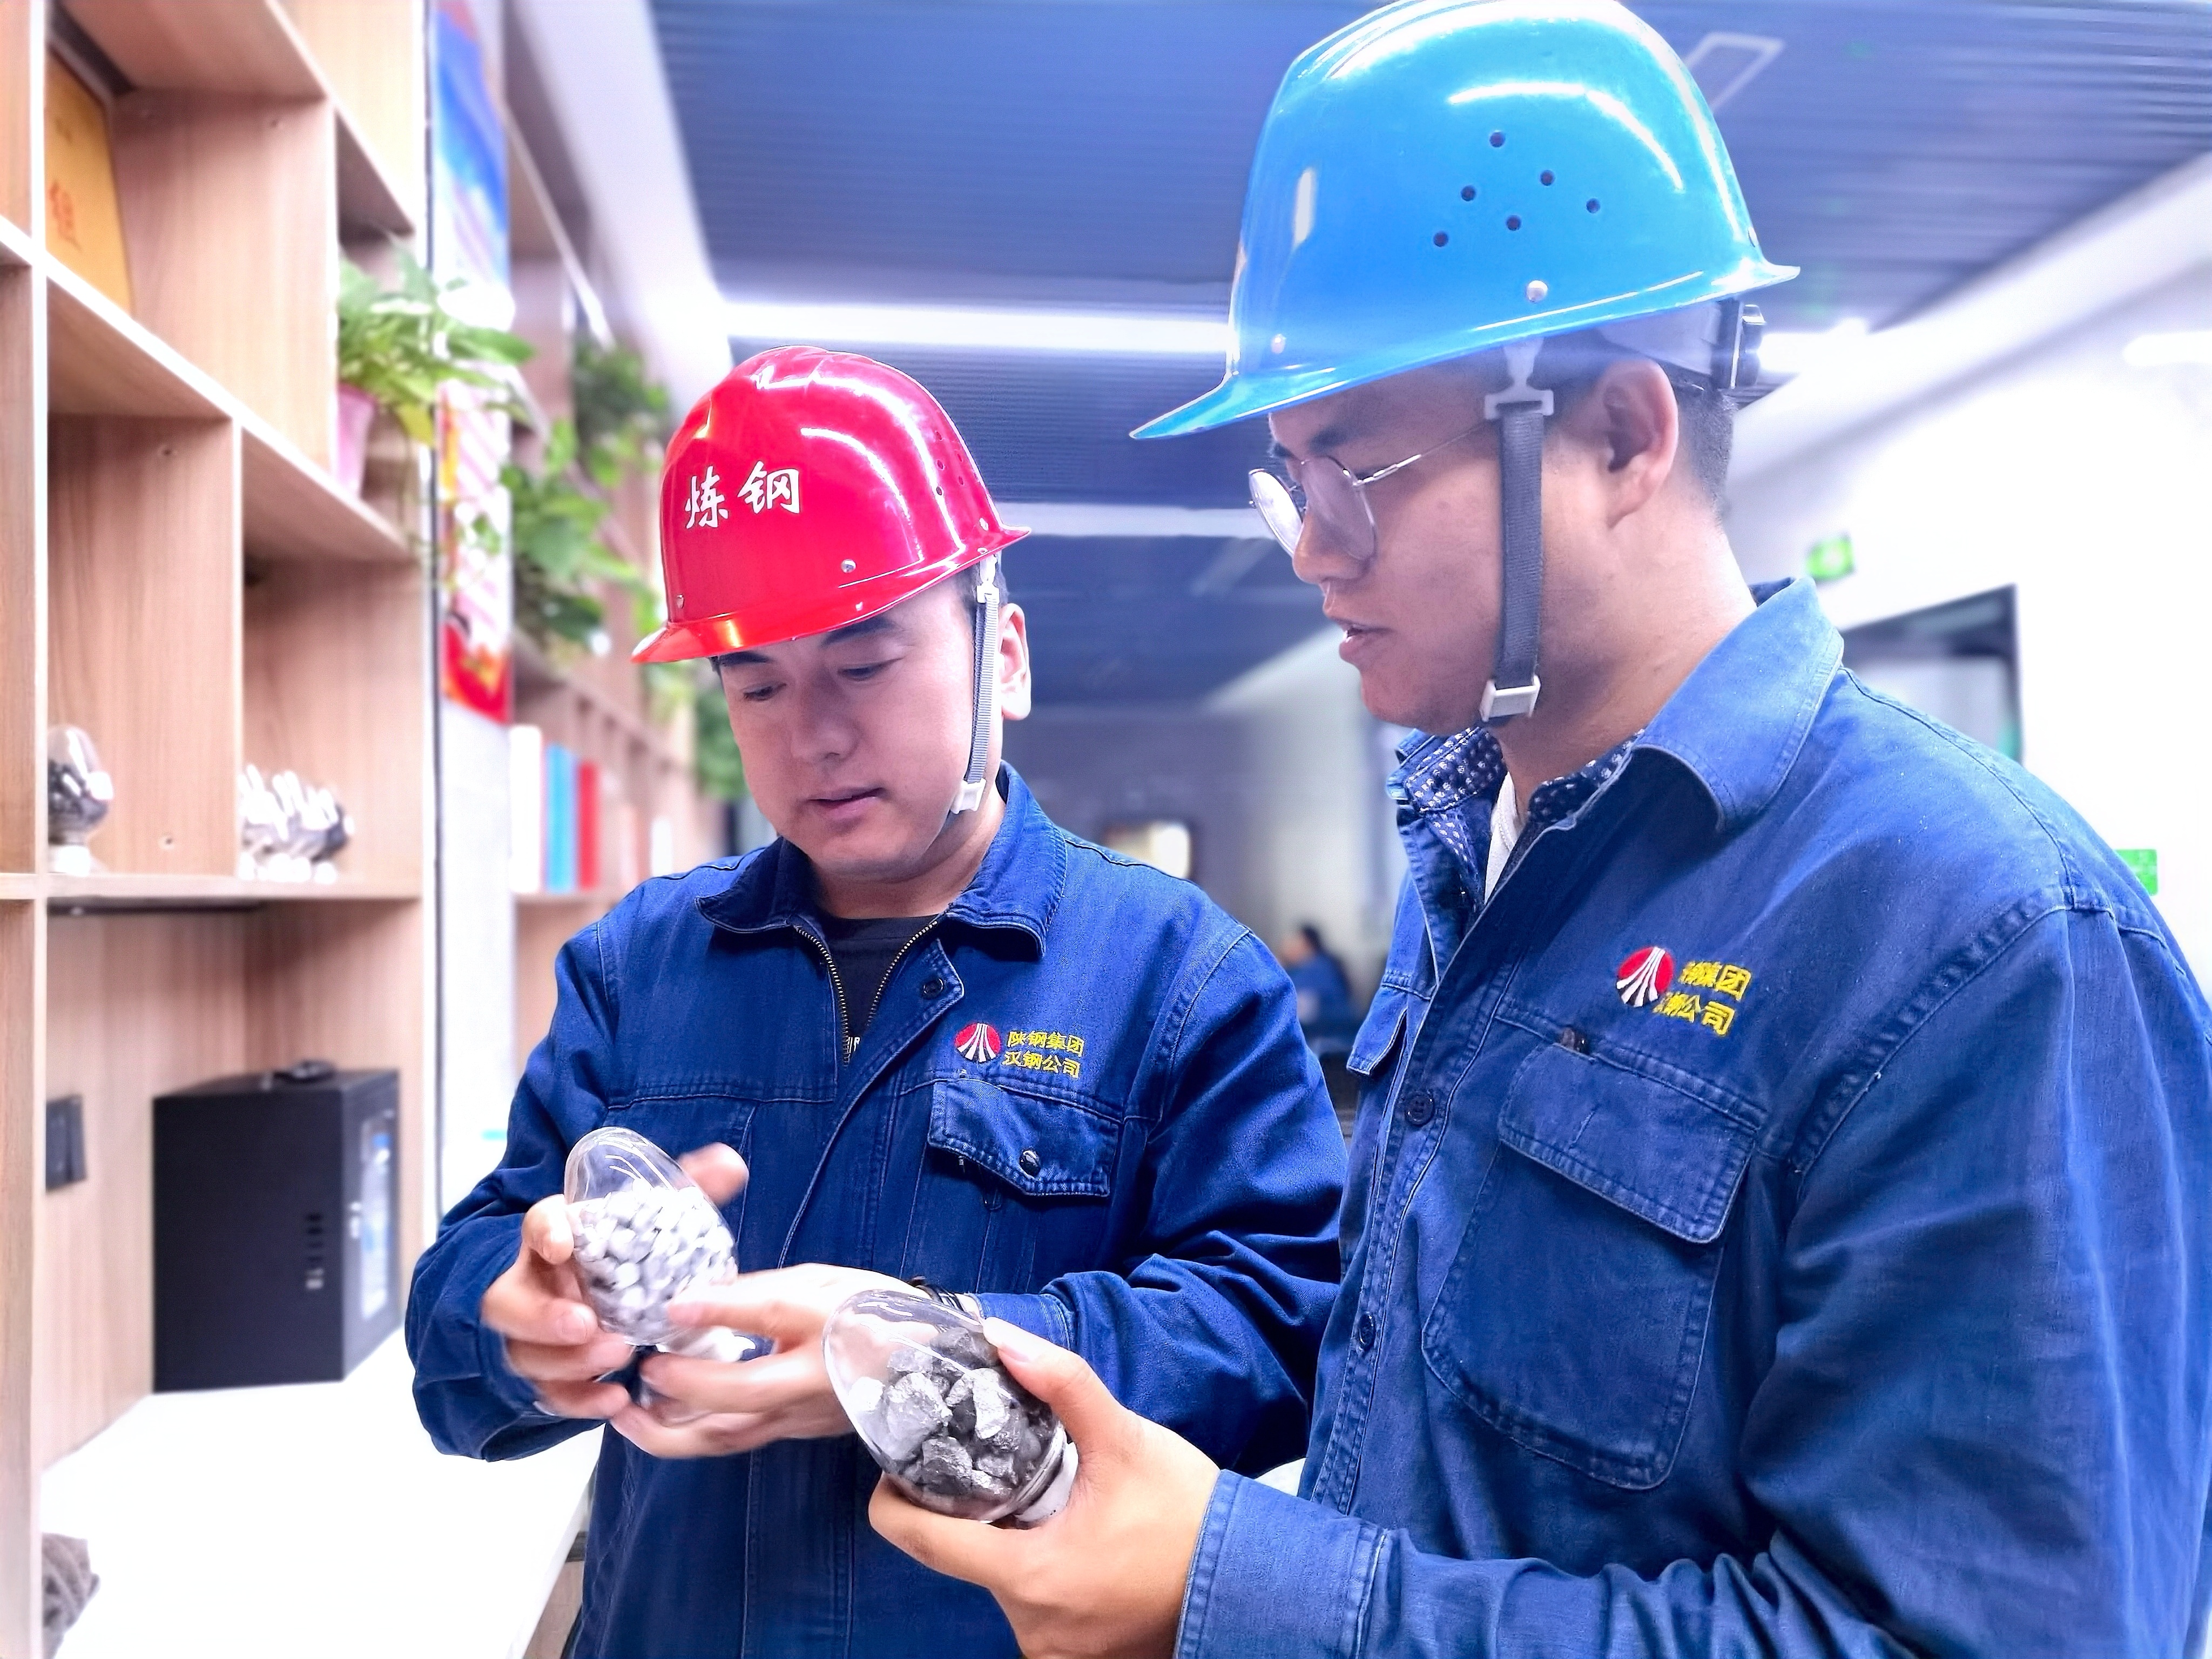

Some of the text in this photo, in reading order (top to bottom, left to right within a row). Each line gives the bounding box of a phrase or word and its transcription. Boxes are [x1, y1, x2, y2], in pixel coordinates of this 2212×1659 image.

[685, 461, 800, 529] 炼钢
[1007, 1030, 1085, 1057] 陕钢集团
[1002, 1050, 1081, 1078] 汉钢公司
